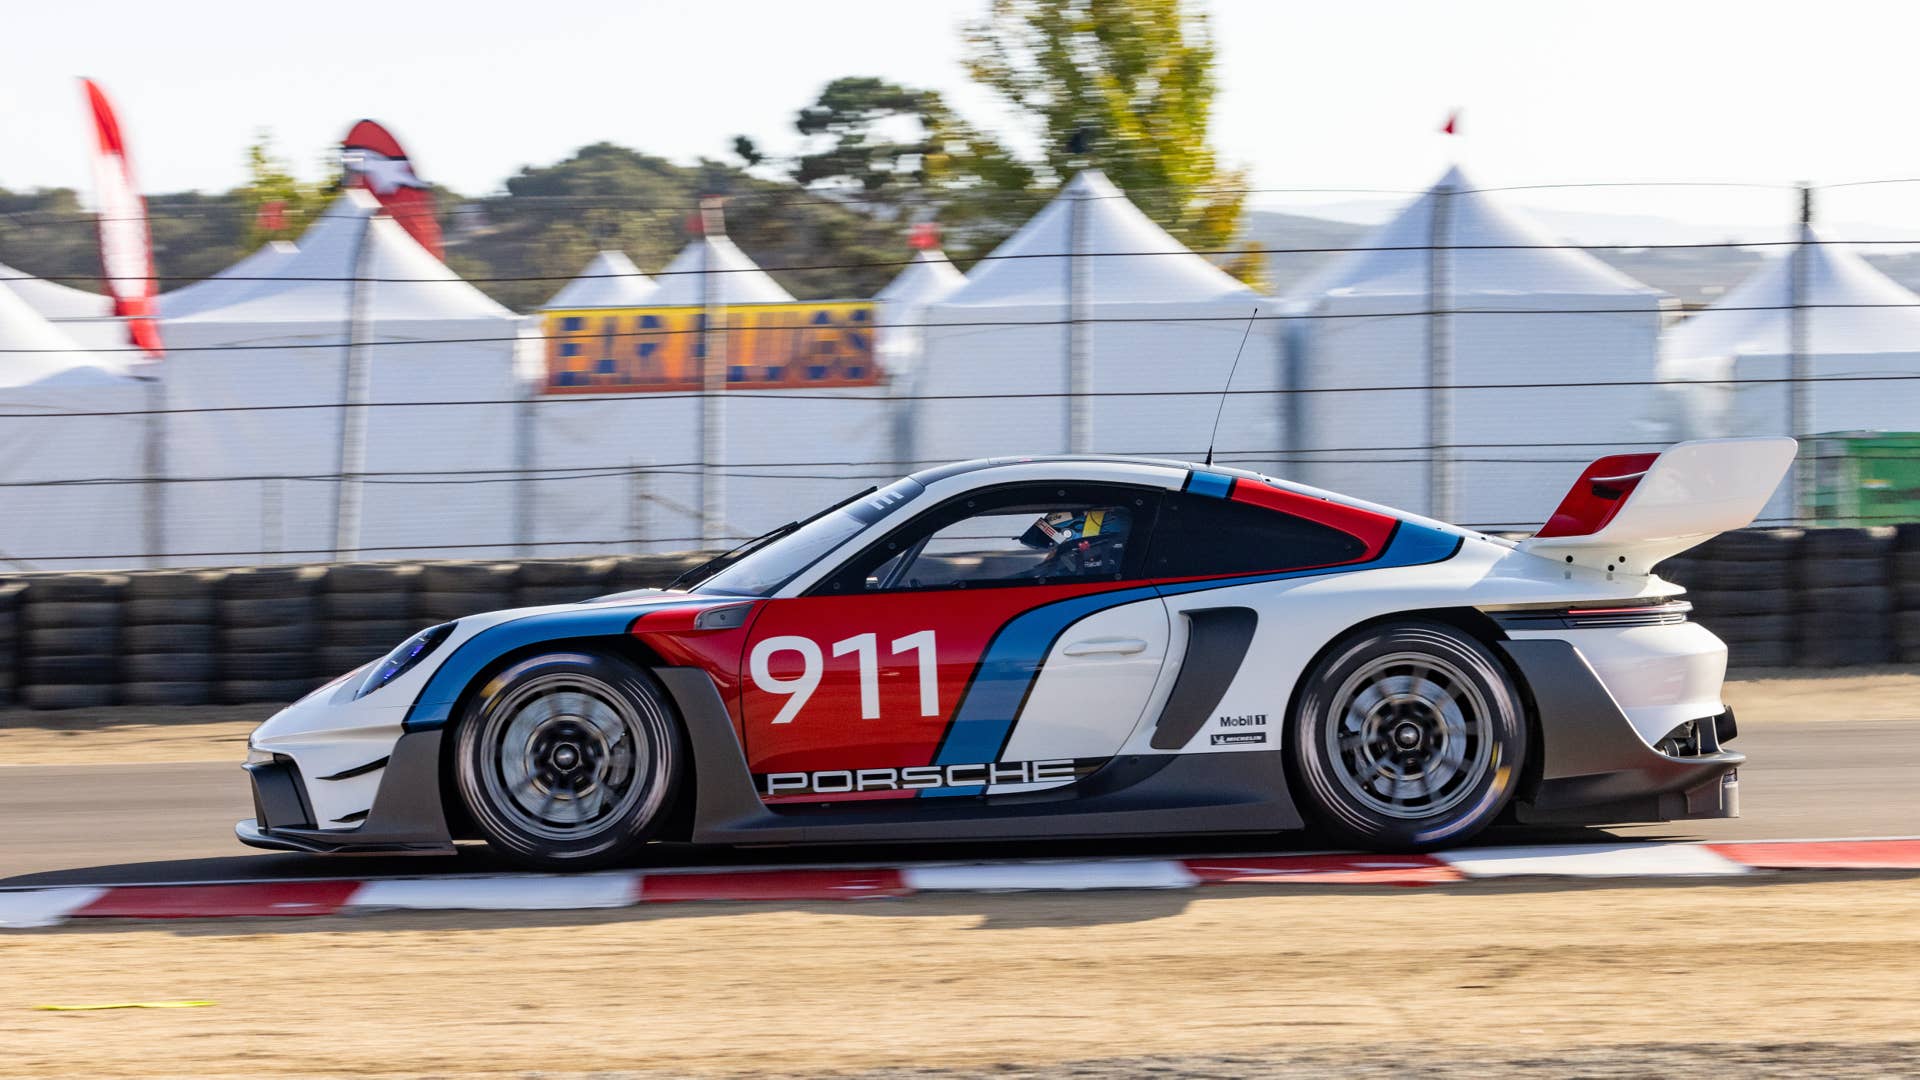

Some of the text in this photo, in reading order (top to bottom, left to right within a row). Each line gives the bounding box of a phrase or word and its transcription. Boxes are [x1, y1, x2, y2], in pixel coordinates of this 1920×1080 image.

[750, 630, 939, 724] 911
[1220, 715, 1253, 727] Mobil
[767, 759, 1076, 795] PORSCHE
